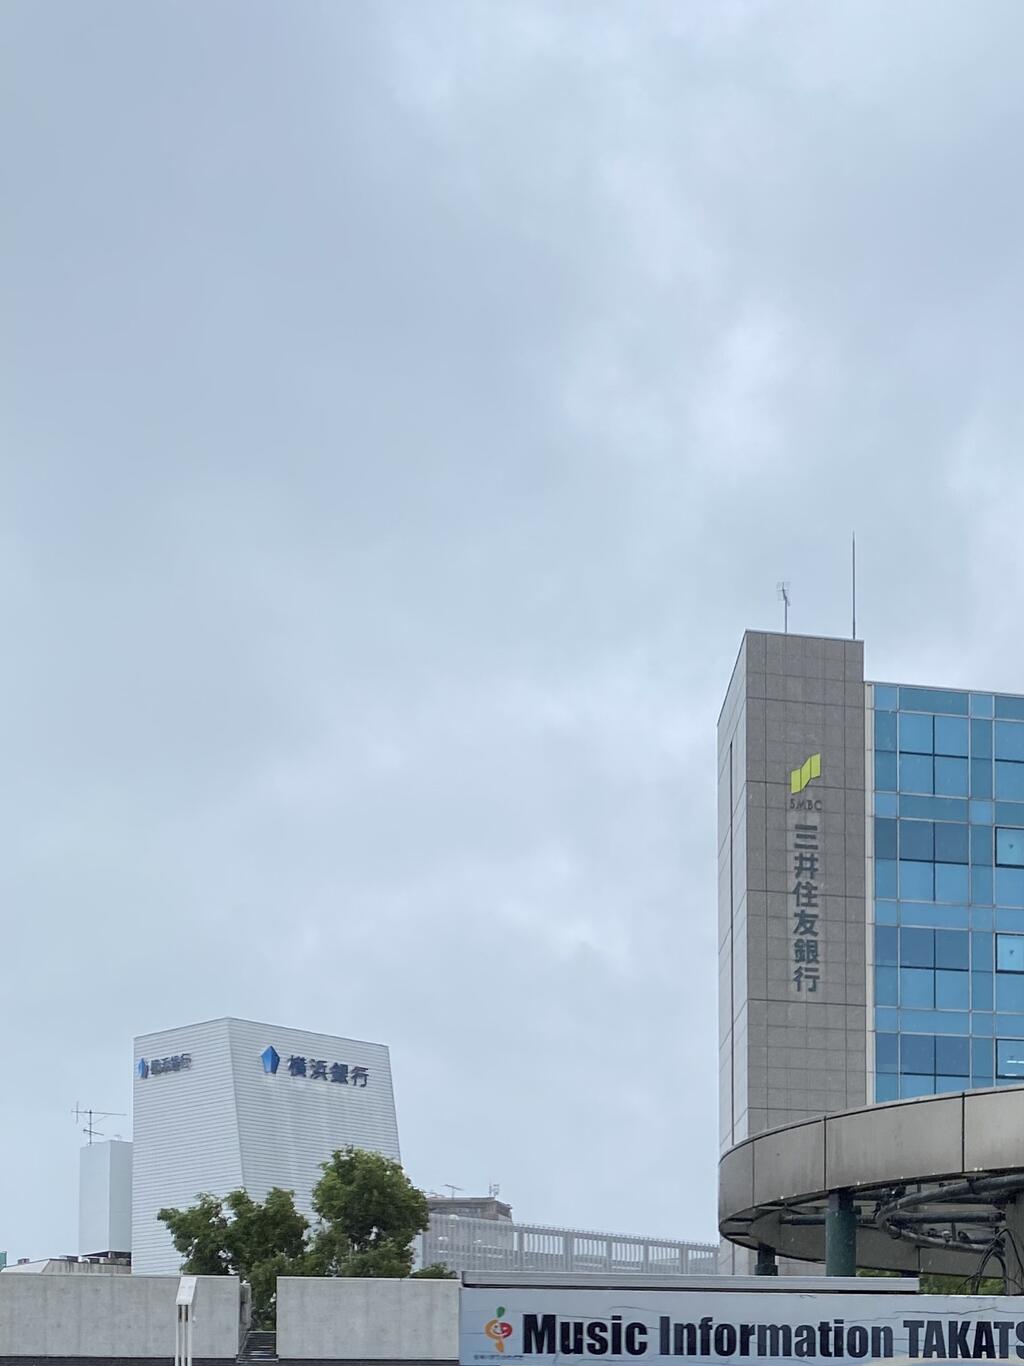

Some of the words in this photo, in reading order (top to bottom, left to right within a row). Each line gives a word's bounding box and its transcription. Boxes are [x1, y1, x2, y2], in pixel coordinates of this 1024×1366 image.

[789, 798, 822, 811] SMBC
[791, 824, 821, 993] 三井住友銀行
[288, 1054, 369, 1088] 横浜銀行
[522, 1313, 648, 1356] Music
[659, 1316, 893, 1358] Information
